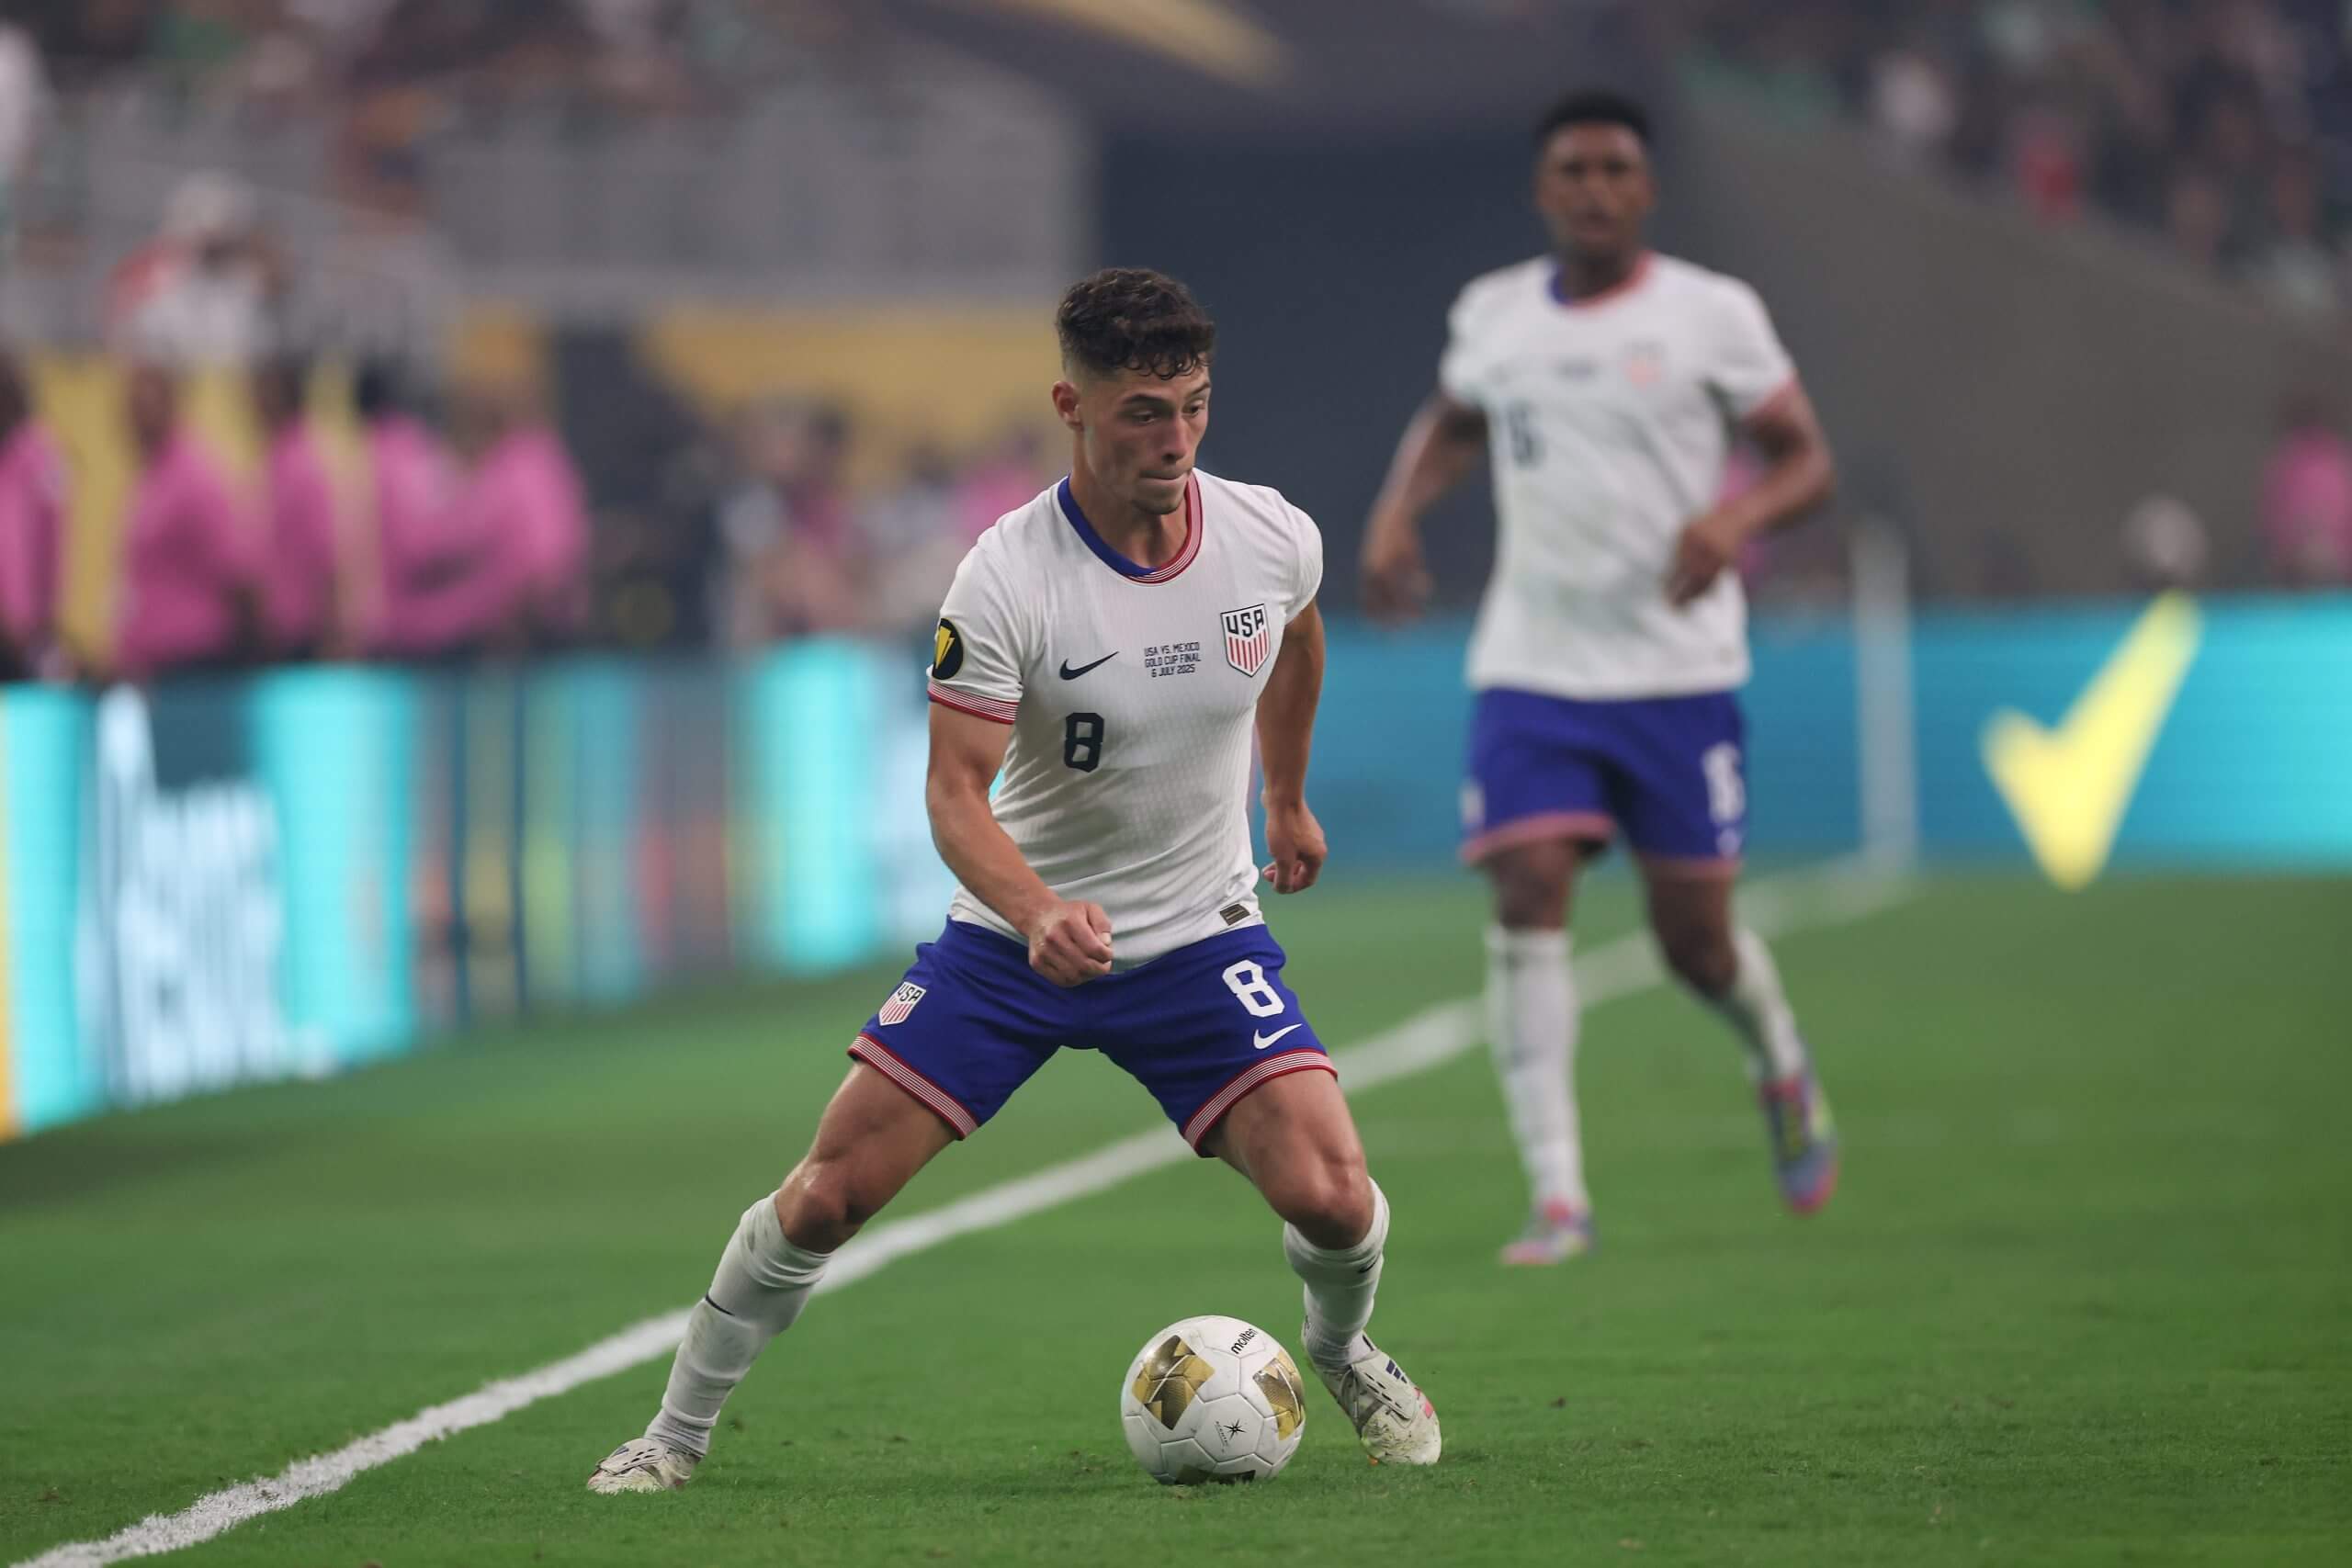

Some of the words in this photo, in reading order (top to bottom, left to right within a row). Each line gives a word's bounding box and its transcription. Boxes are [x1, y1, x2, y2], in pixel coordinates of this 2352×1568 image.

[1226, 609, 1264, 637] USA
[1145, 647, 1159, 657] USA
[1173, 642, 1200, 653] MEXICO
[1146, 657, 1162, 668] GOLD
[1164, 655, 1178, 665] CUP
[1181, 653, 1201, 663] FINAL
[1159, 667, 1175, 677] JULY
[1177, 664, 1195, 674] 2025
[1064, 712, 1104, 773] 8
[898, 984, 923, 1001] USA
[1222, 959, 1285, 1018] 8
[1230, 1328, 1258, 1354] molten
